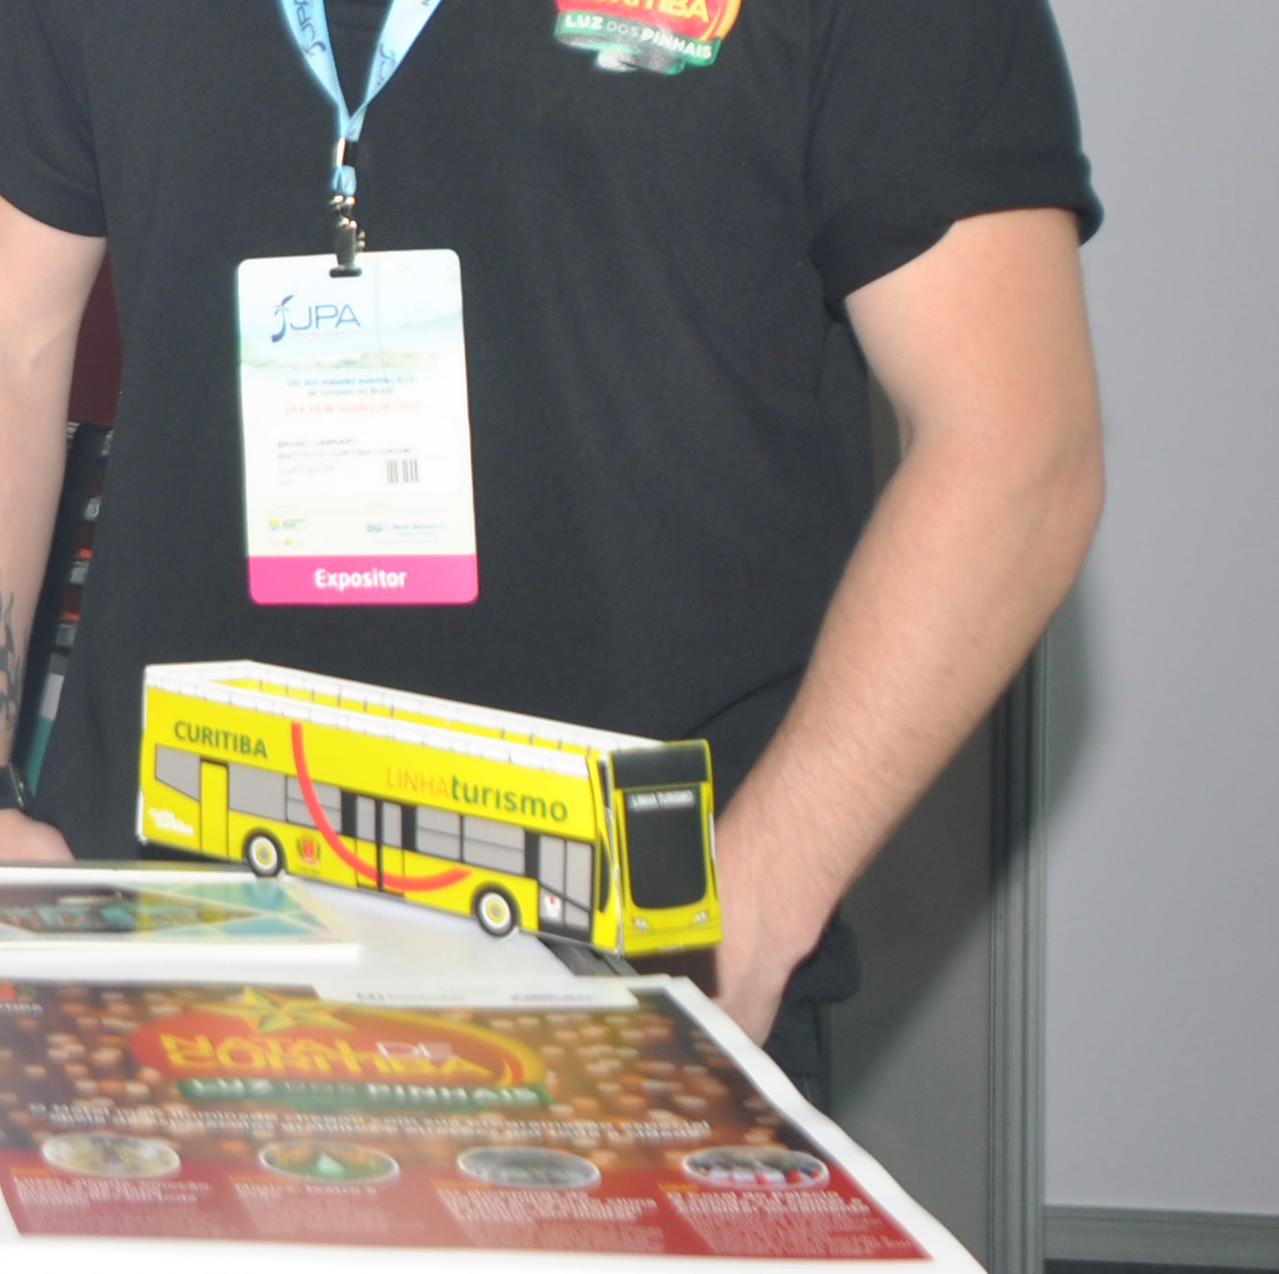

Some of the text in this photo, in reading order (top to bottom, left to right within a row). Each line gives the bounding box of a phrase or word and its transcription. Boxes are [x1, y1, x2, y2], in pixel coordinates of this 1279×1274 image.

[564, 15, 712, 59] LUZ DOS PINHAIS
[289, 303, 362, 331] JPA
[314, 568, 408, 591] Expositor
[174, 719, 267, 759] CURITIBA
